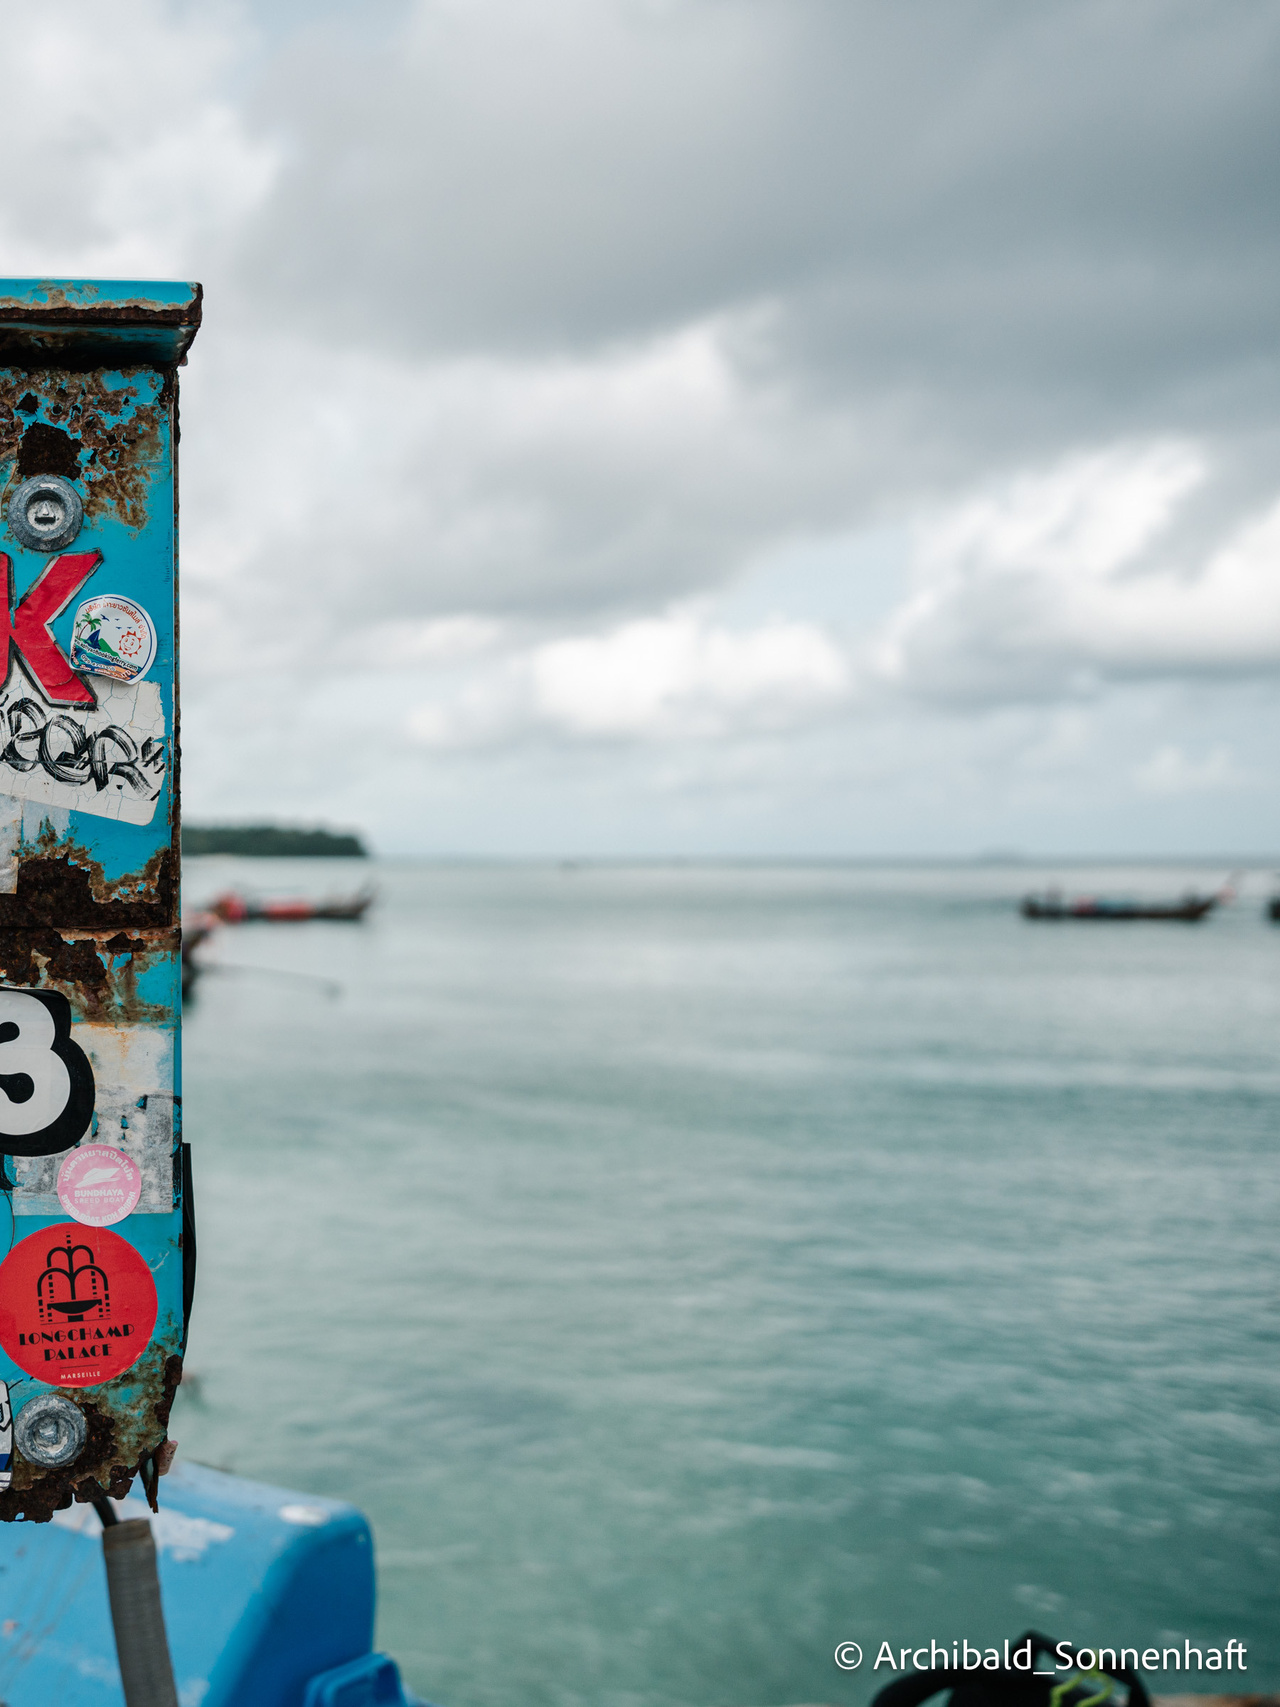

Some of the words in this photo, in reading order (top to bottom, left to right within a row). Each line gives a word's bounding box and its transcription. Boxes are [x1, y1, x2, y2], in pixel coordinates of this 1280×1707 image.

[74, 1189, 124, 1198] BUNDHAYA
[19, 1324, 135, 1346] LONGCHAMP
[44, 1344, 113, 1361] PALACE
[60, 1371, 101, 1380] MARSEILLE
